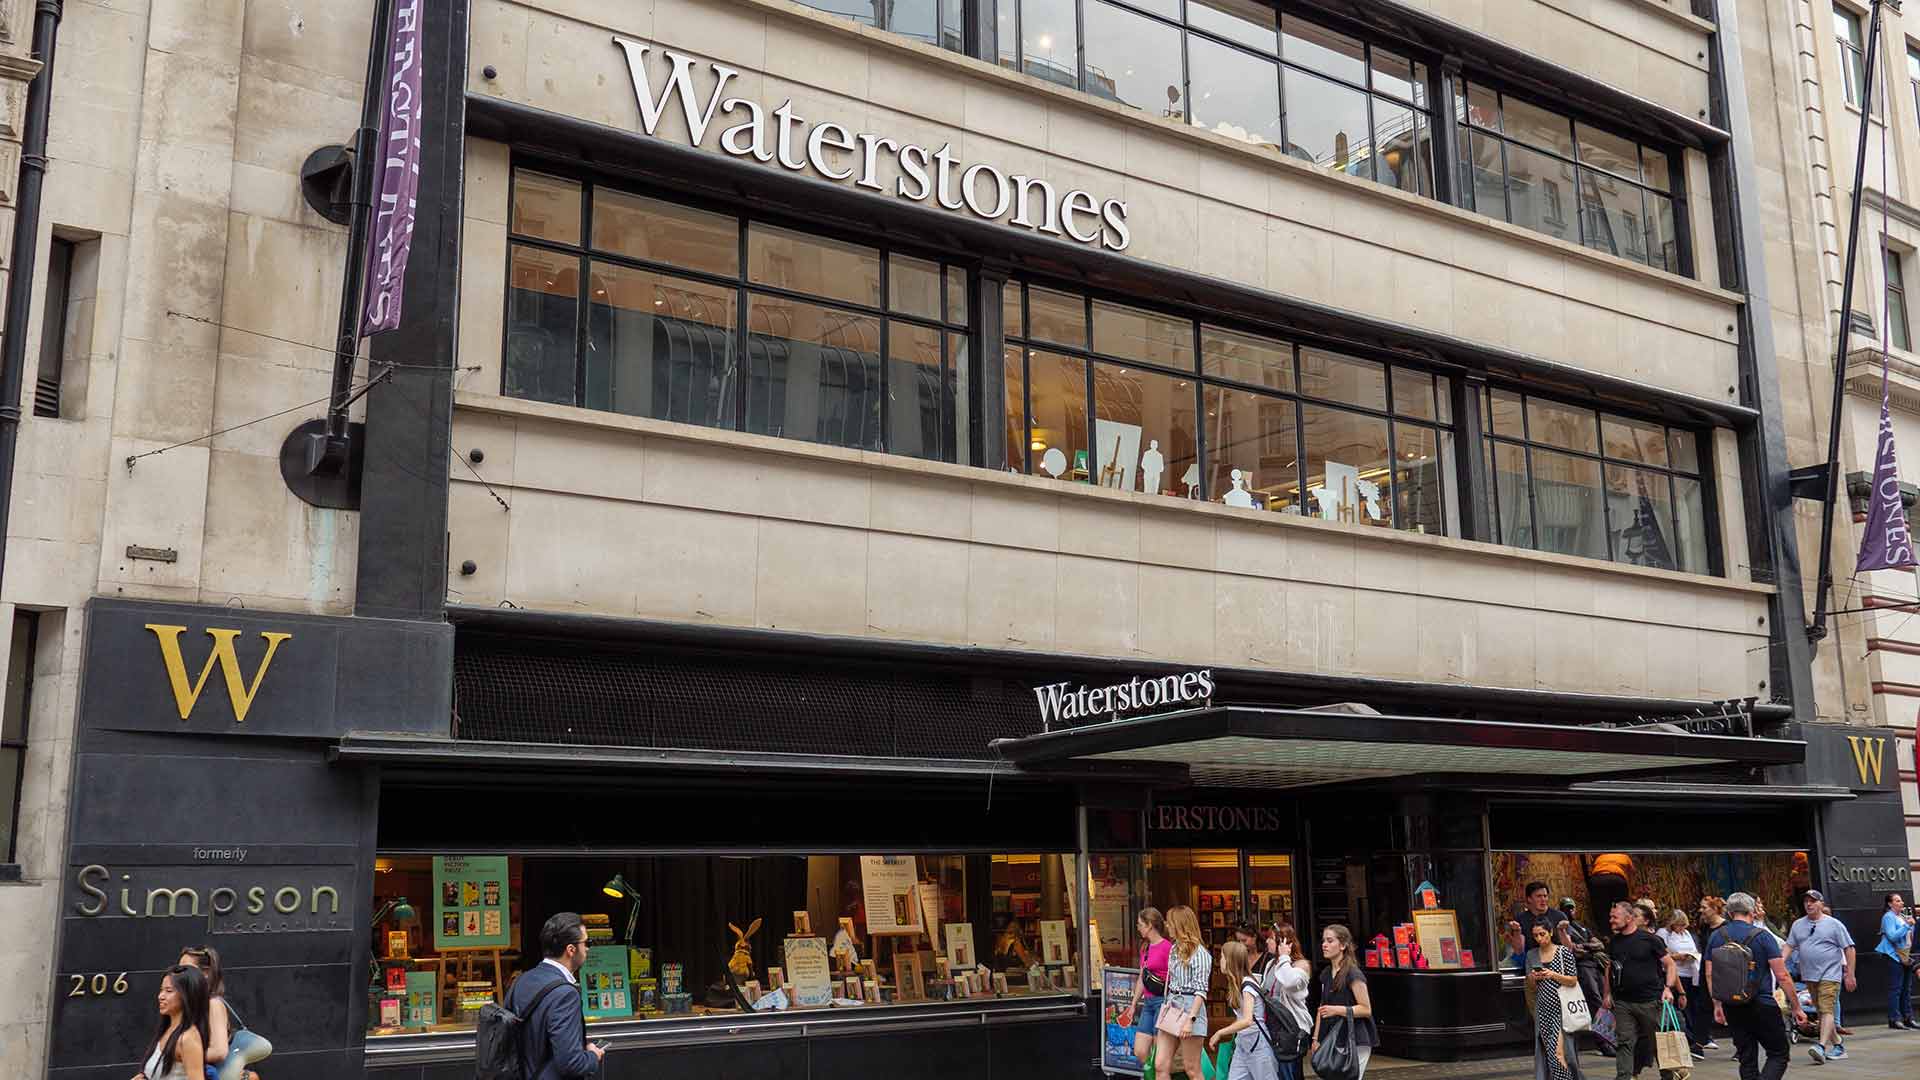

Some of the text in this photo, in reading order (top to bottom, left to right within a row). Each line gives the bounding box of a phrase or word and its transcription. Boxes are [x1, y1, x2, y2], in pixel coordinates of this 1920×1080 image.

[612, 36, 1130, 251] Waterstones
[145, 623, 293, 722] W
[1033, 669, 1215, 723] Waterstones
[1847, 736, 1885, 785] W
[193, 847, 248, 861] formerly
[77, 864, 338, 933] Simpson
[69, 972, 129, 998] 206
